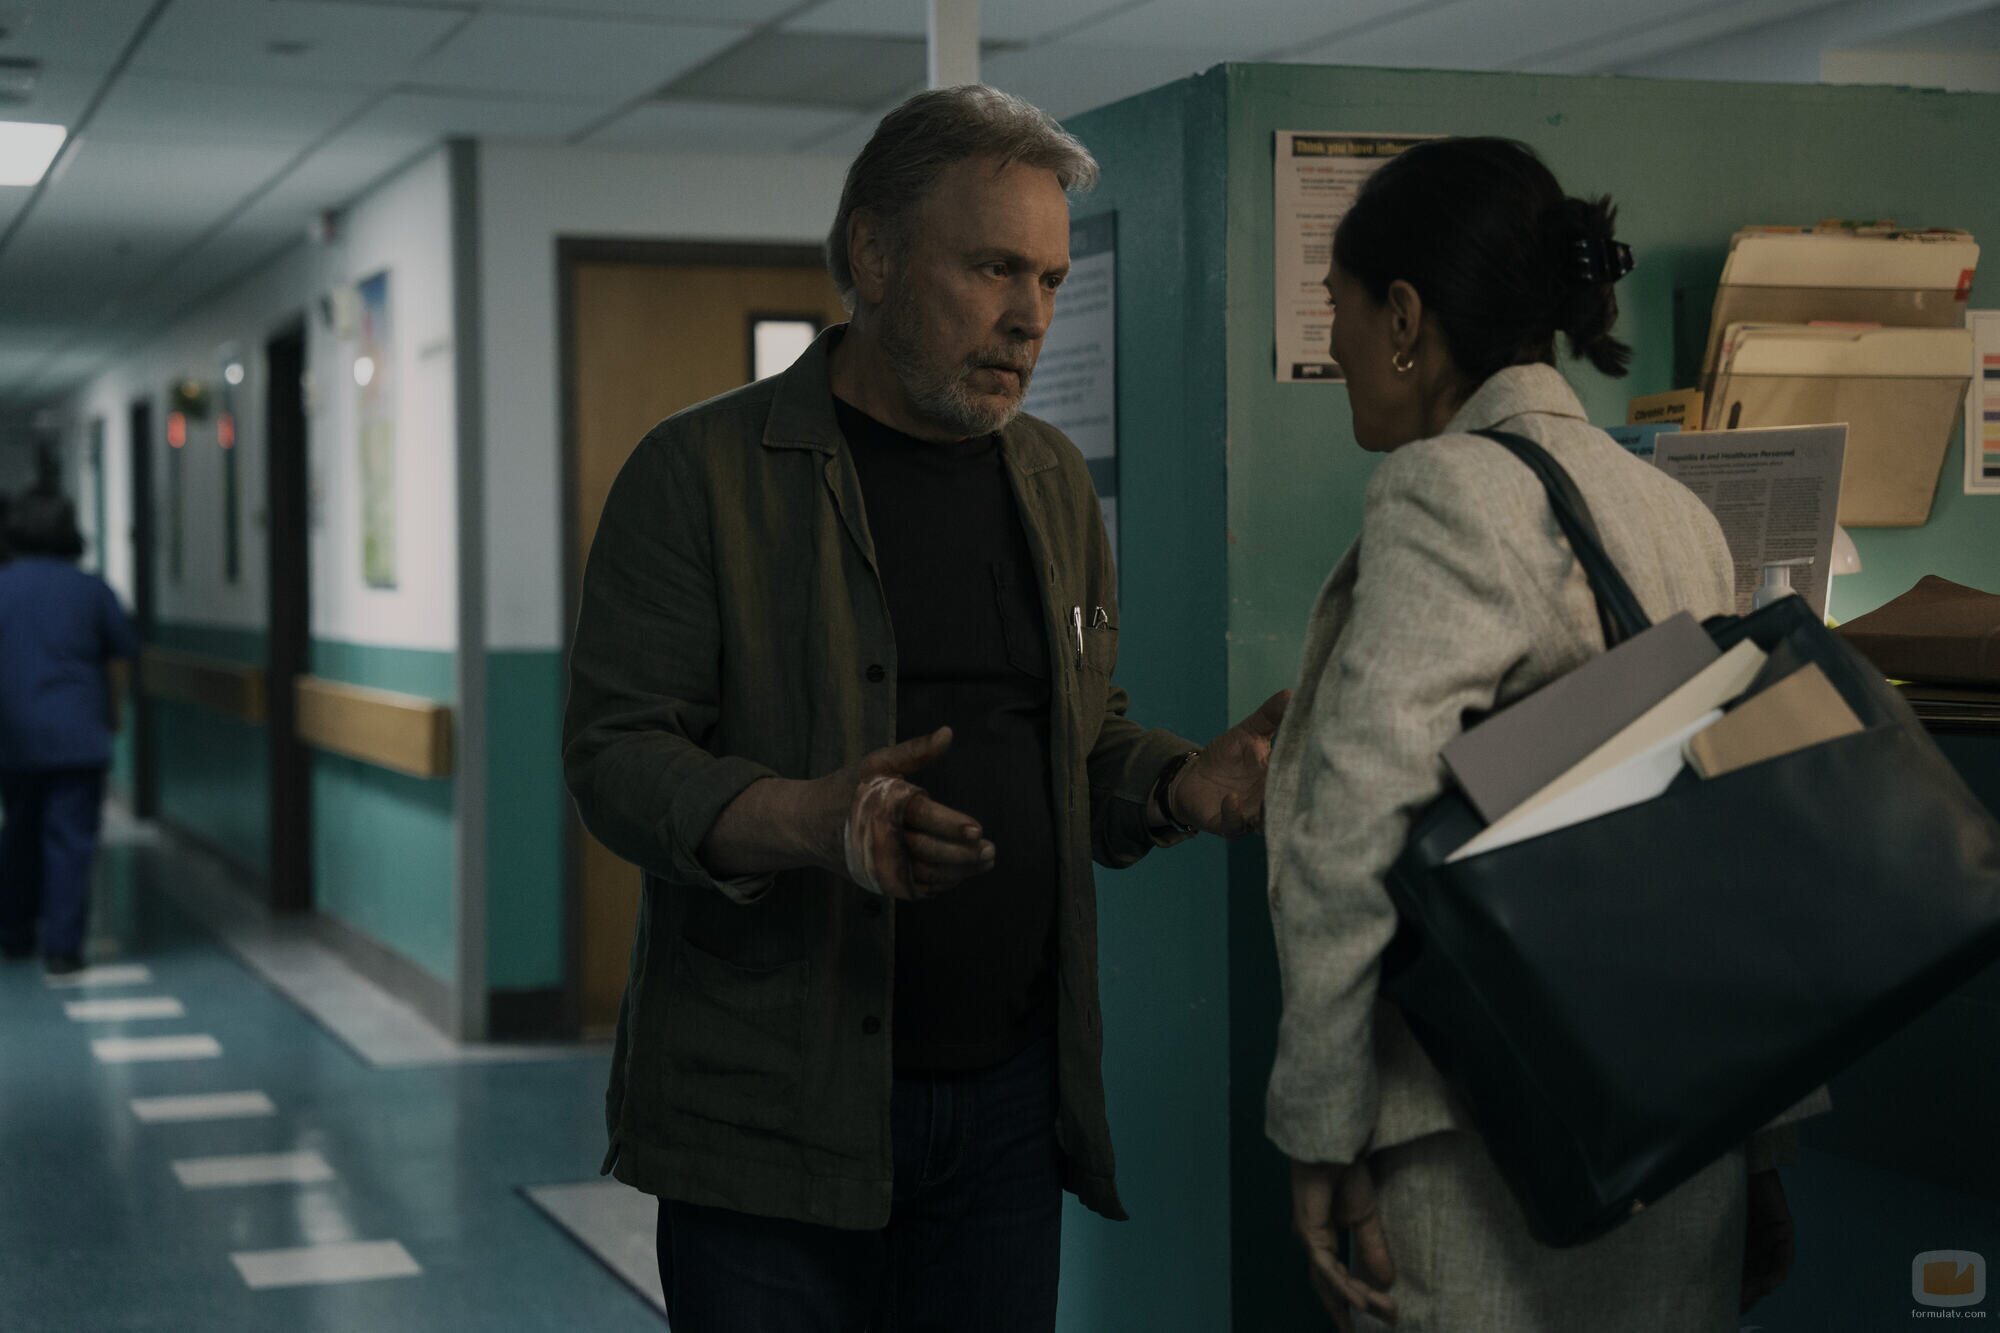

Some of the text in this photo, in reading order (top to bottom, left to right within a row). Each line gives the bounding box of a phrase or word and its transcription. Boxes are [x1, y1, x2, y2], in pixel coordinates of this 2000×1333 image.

[1327, 142, 1347, 156] you
[1347, 140, 1375, 154] have
[1634, 407, 1665, 421] Chronic
[1666, 404, 1685, 415] Pain
[1667, 453, 1698, 463] Hepatitis
[1706, 452, 1719, 460] and
[1721, 451, 1759, 460] Healthcare
[1760, 448, 1795, 458] Personnel
